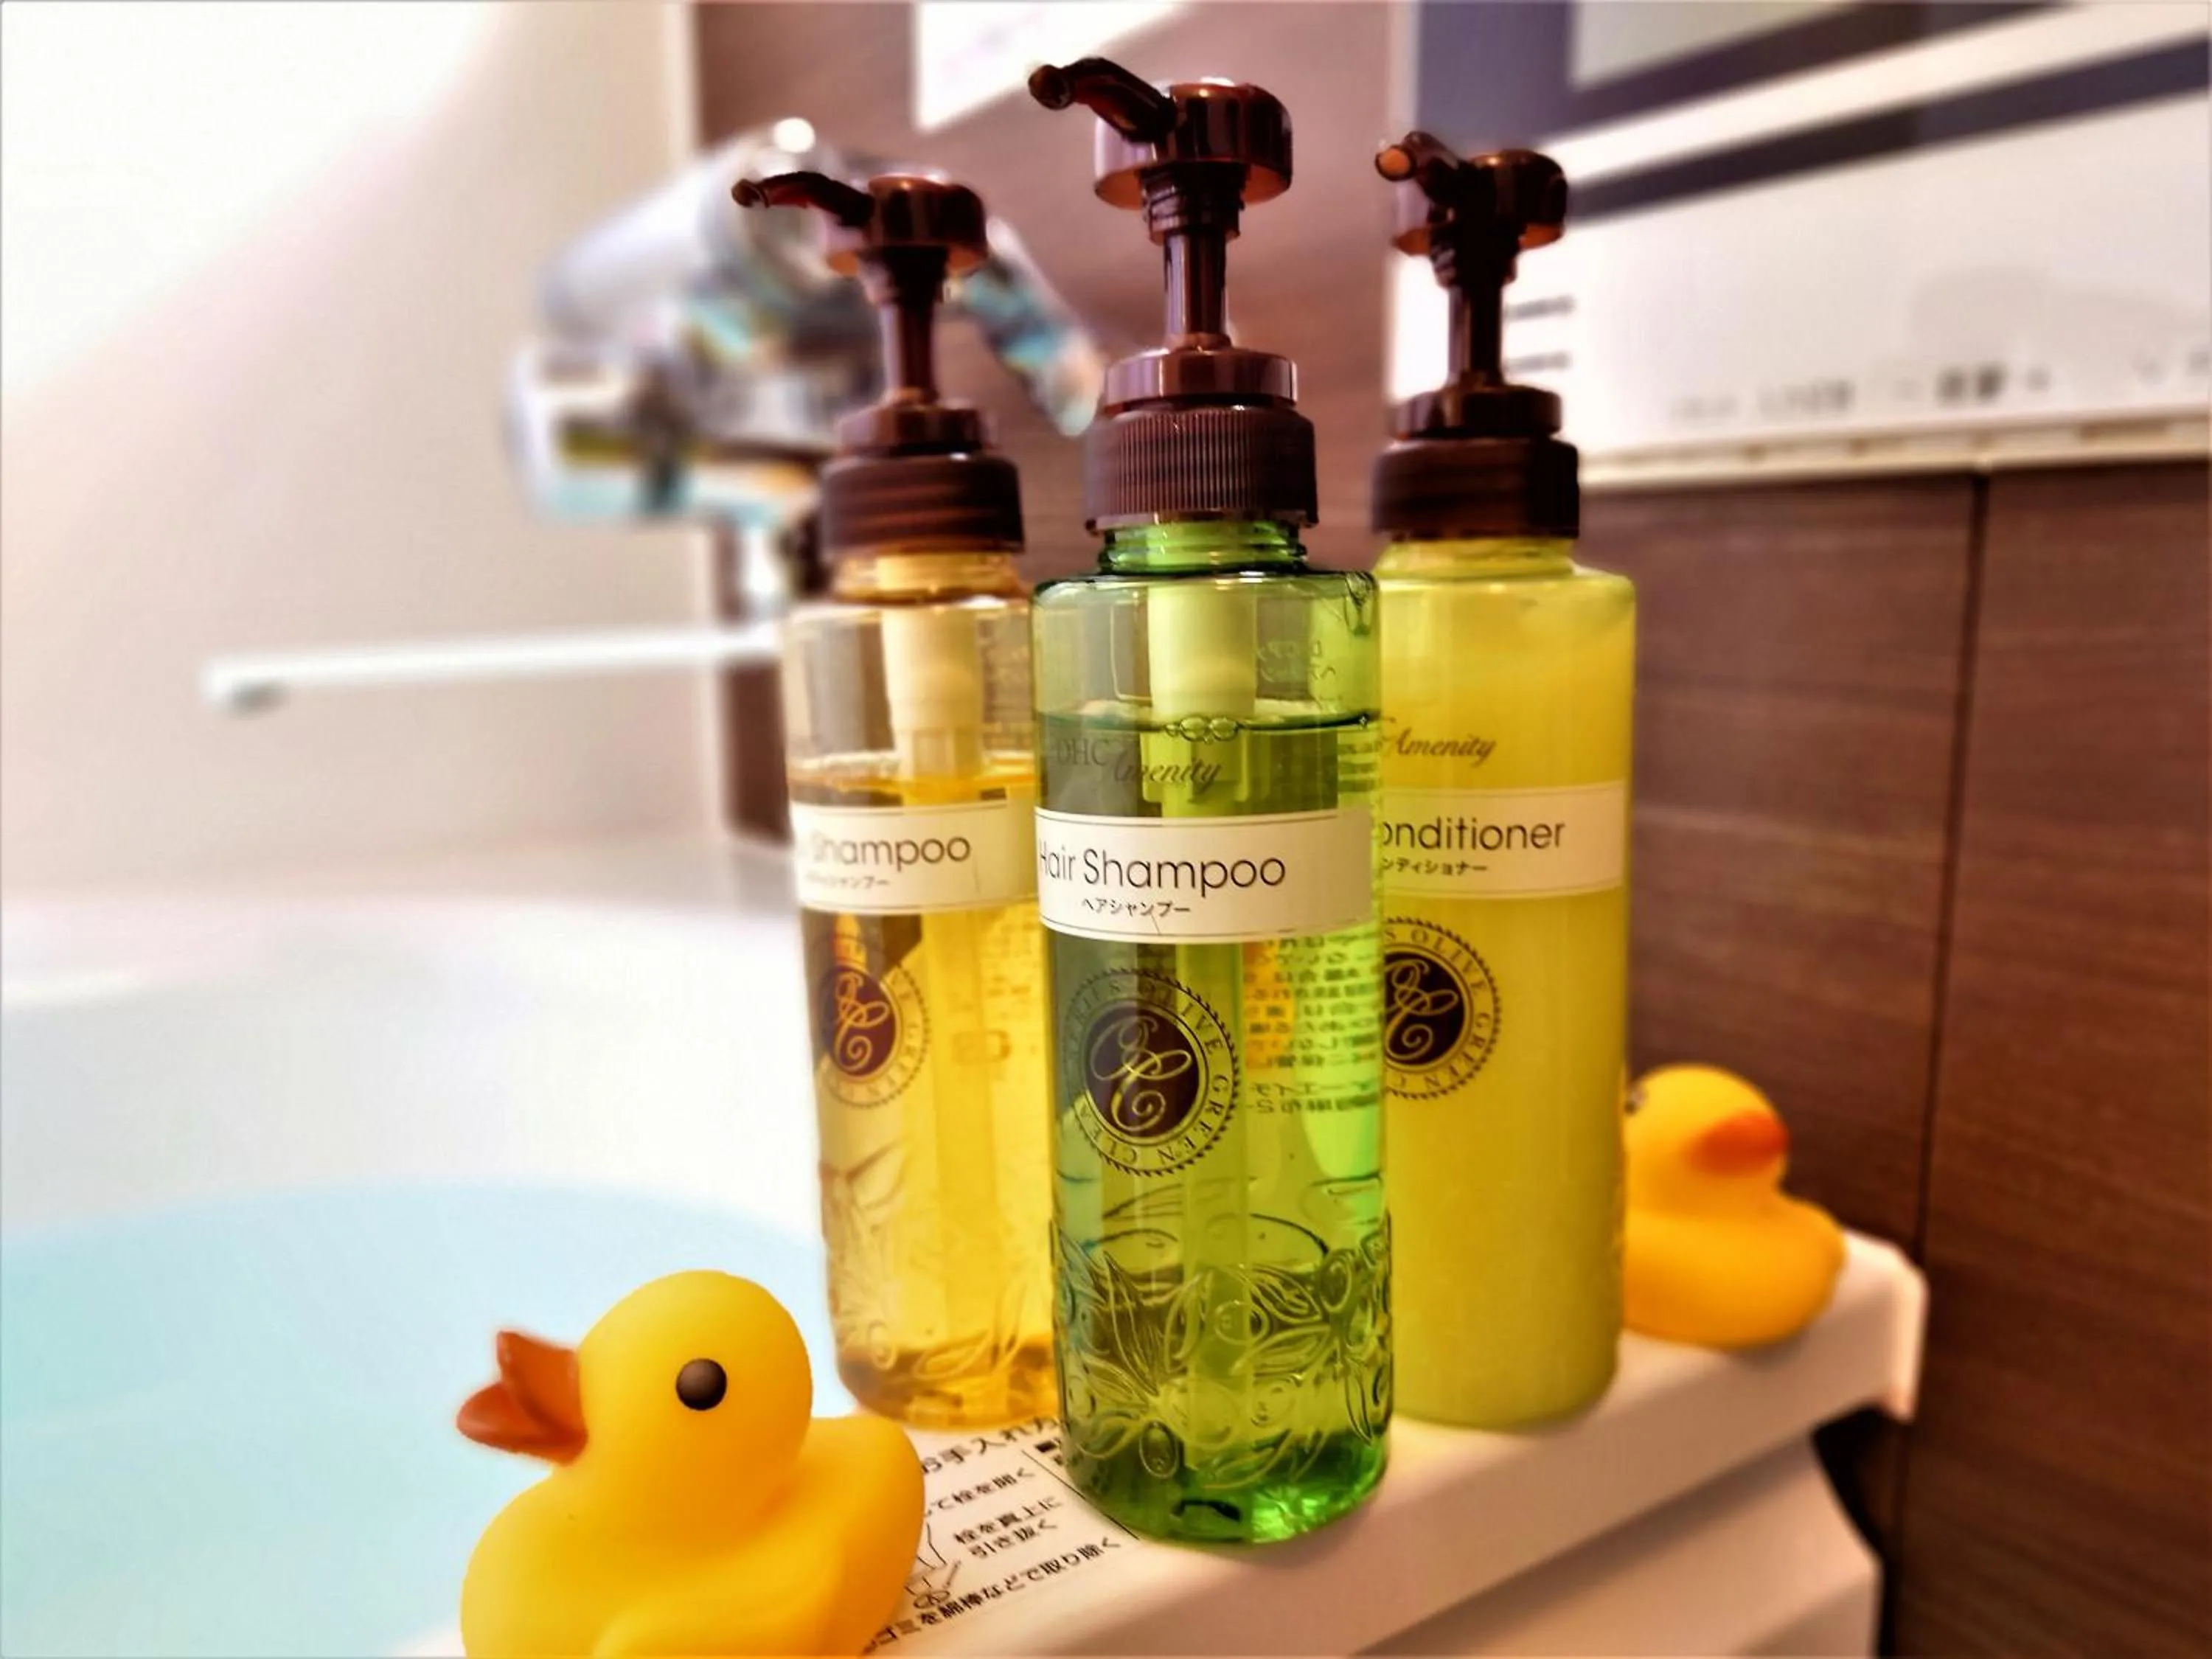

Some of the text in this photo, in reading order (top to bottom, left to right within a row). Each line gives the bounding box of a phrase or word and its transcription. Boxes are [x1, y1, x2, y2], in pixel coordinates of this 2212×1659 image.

[1057, 737, 1108, 766] DHC
[1381, 816, 1566, 851] onditioner
[1039, 838, 1286, 897] Hair Shampoo
[1381, 857, 1488, 876] ンディショナー
[1080, 897, 1192, 918] ヘアシャンプー
[969, 1519, 1057, 1558] 引き抜く
